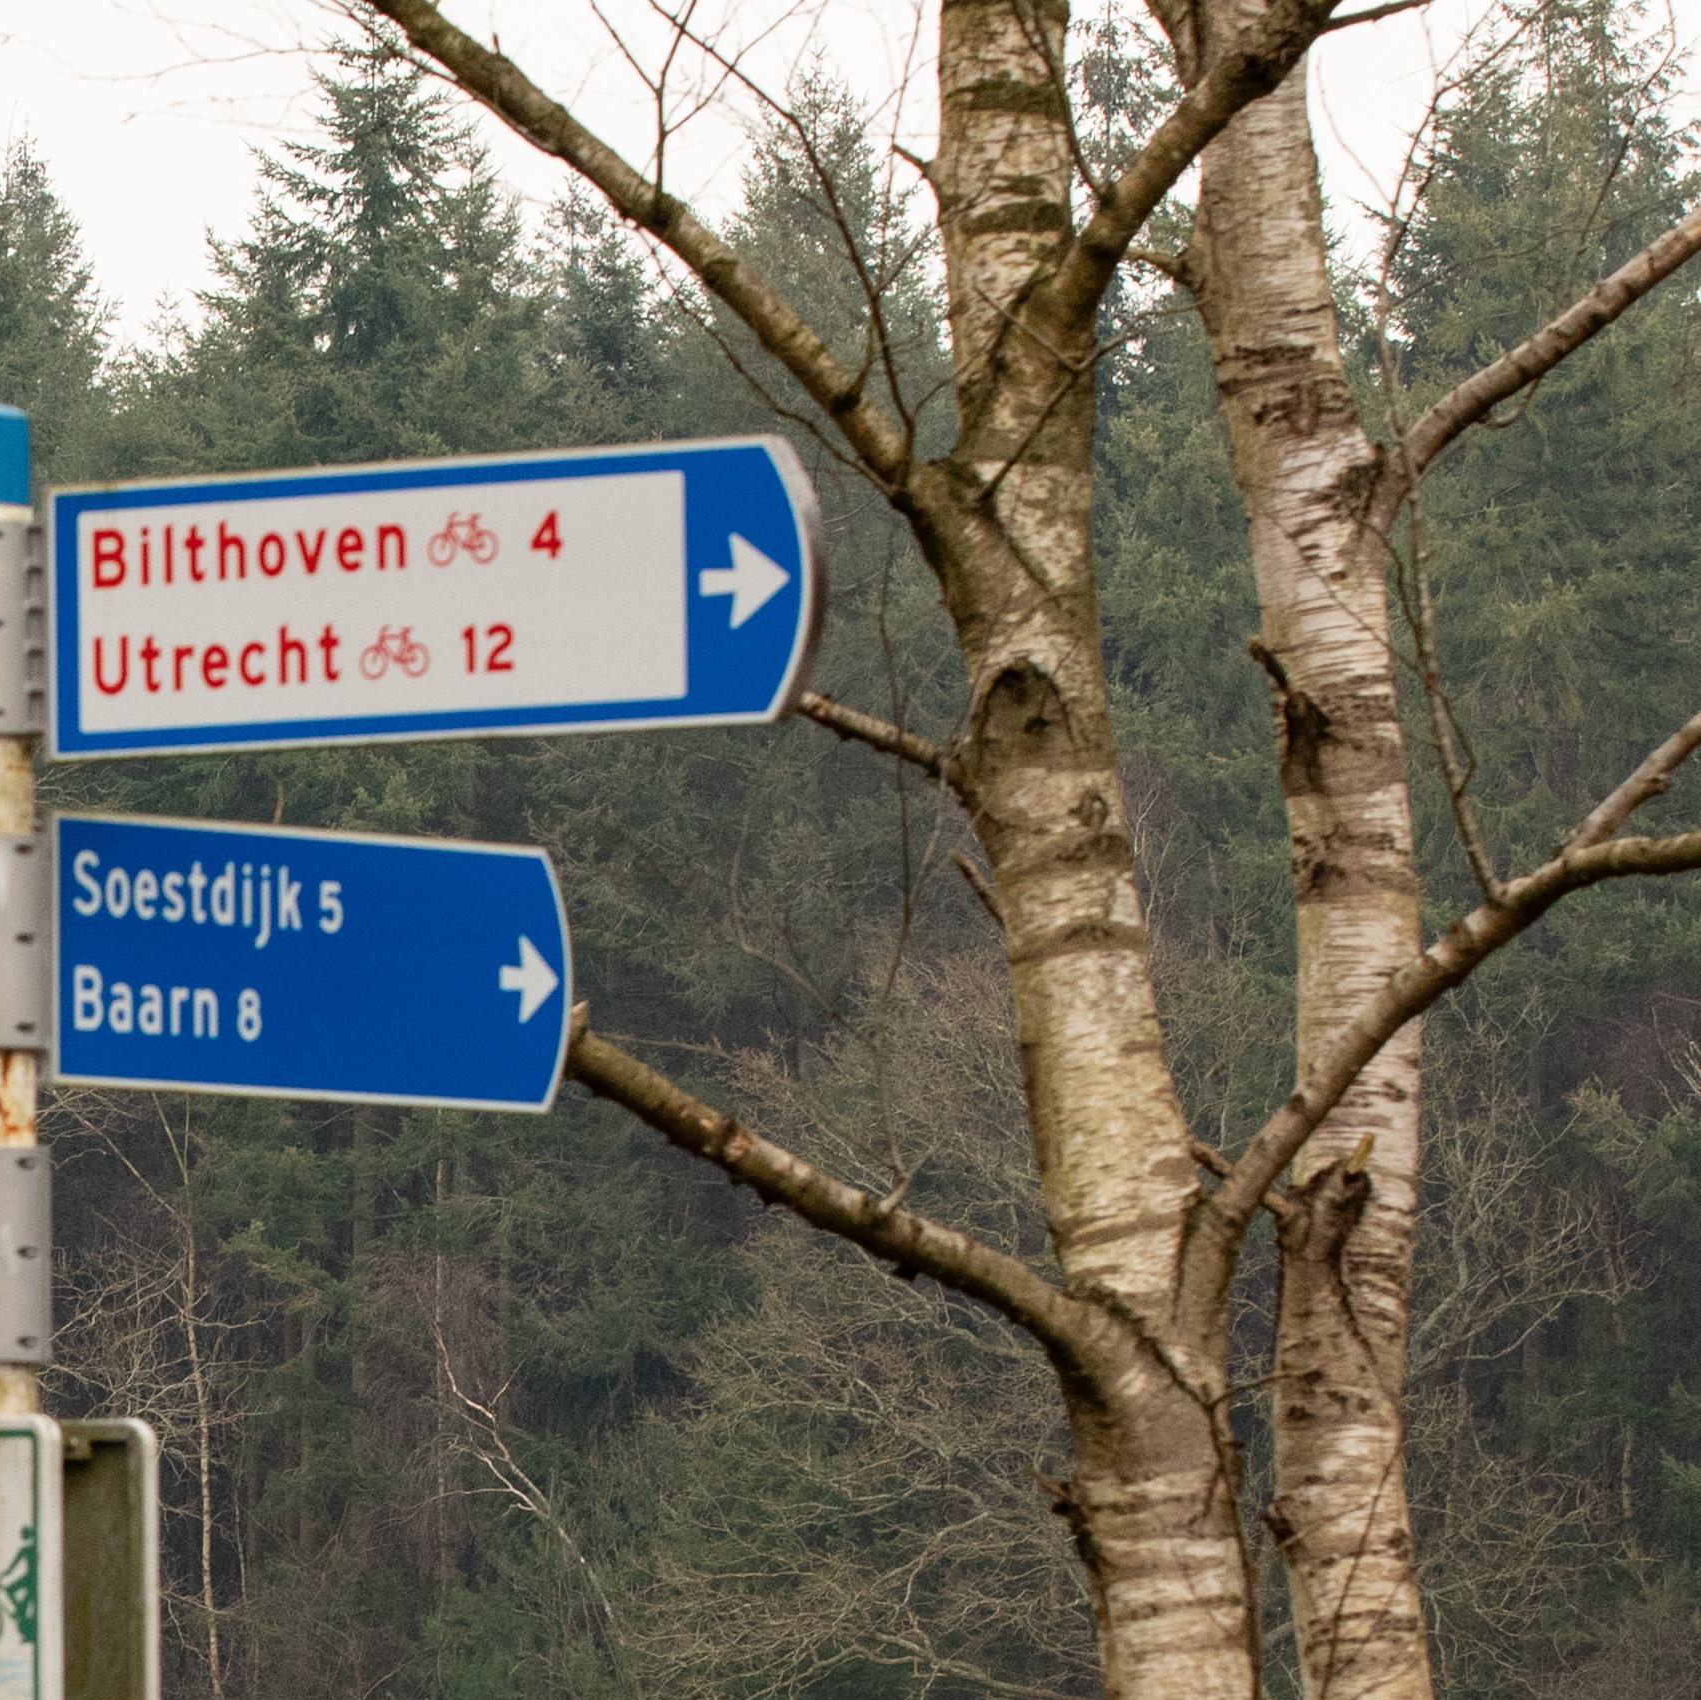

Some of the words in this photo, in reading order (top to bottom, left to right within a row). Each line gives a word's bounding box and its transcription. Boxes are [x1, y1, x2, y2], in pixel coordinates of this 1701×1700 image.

[92, 521, 407, 590] Bilthoven
[529, 511, 563, 558] 4
[93, 625, 340, 696] Utrecht
[462, 623, 514, 673] 12
[74, 850, 301, 948] Soestdijk
[320, 880, 343, 933] 5
[74, 964, 219, 1037] Baarn
[238, 988, 262, 1041] 8
